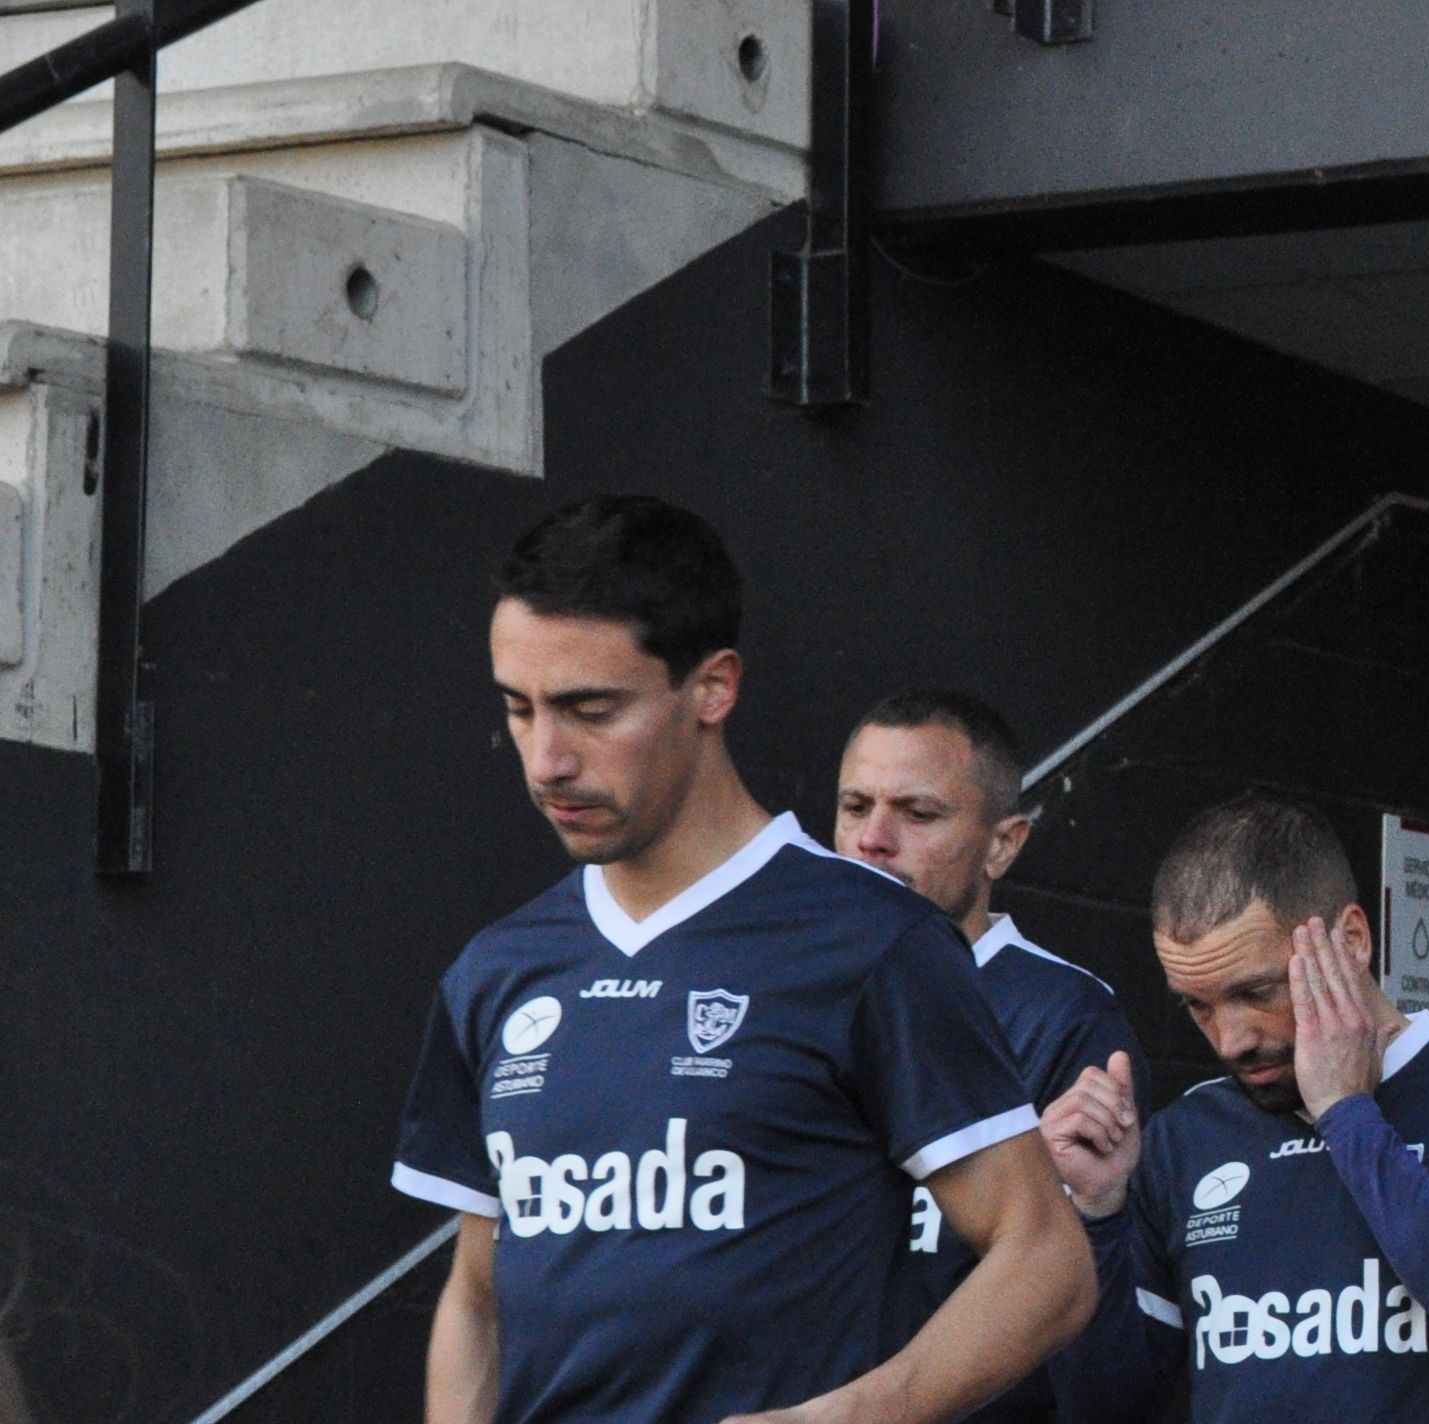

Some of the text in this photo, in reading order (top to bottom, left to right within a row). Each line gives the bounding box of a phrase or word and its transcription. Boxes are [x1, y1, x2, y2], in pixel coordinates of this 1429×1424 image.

[1270, 1138, 1331, 1159] JOLU
[486, 1117, 746, 1240] Posada
[1186, 1211, 1240, 1229] DEPORTE
[1185, 1225, 1238, 1242] ASTURIANO
[1191, 1258, 1428, 1370] Posada
